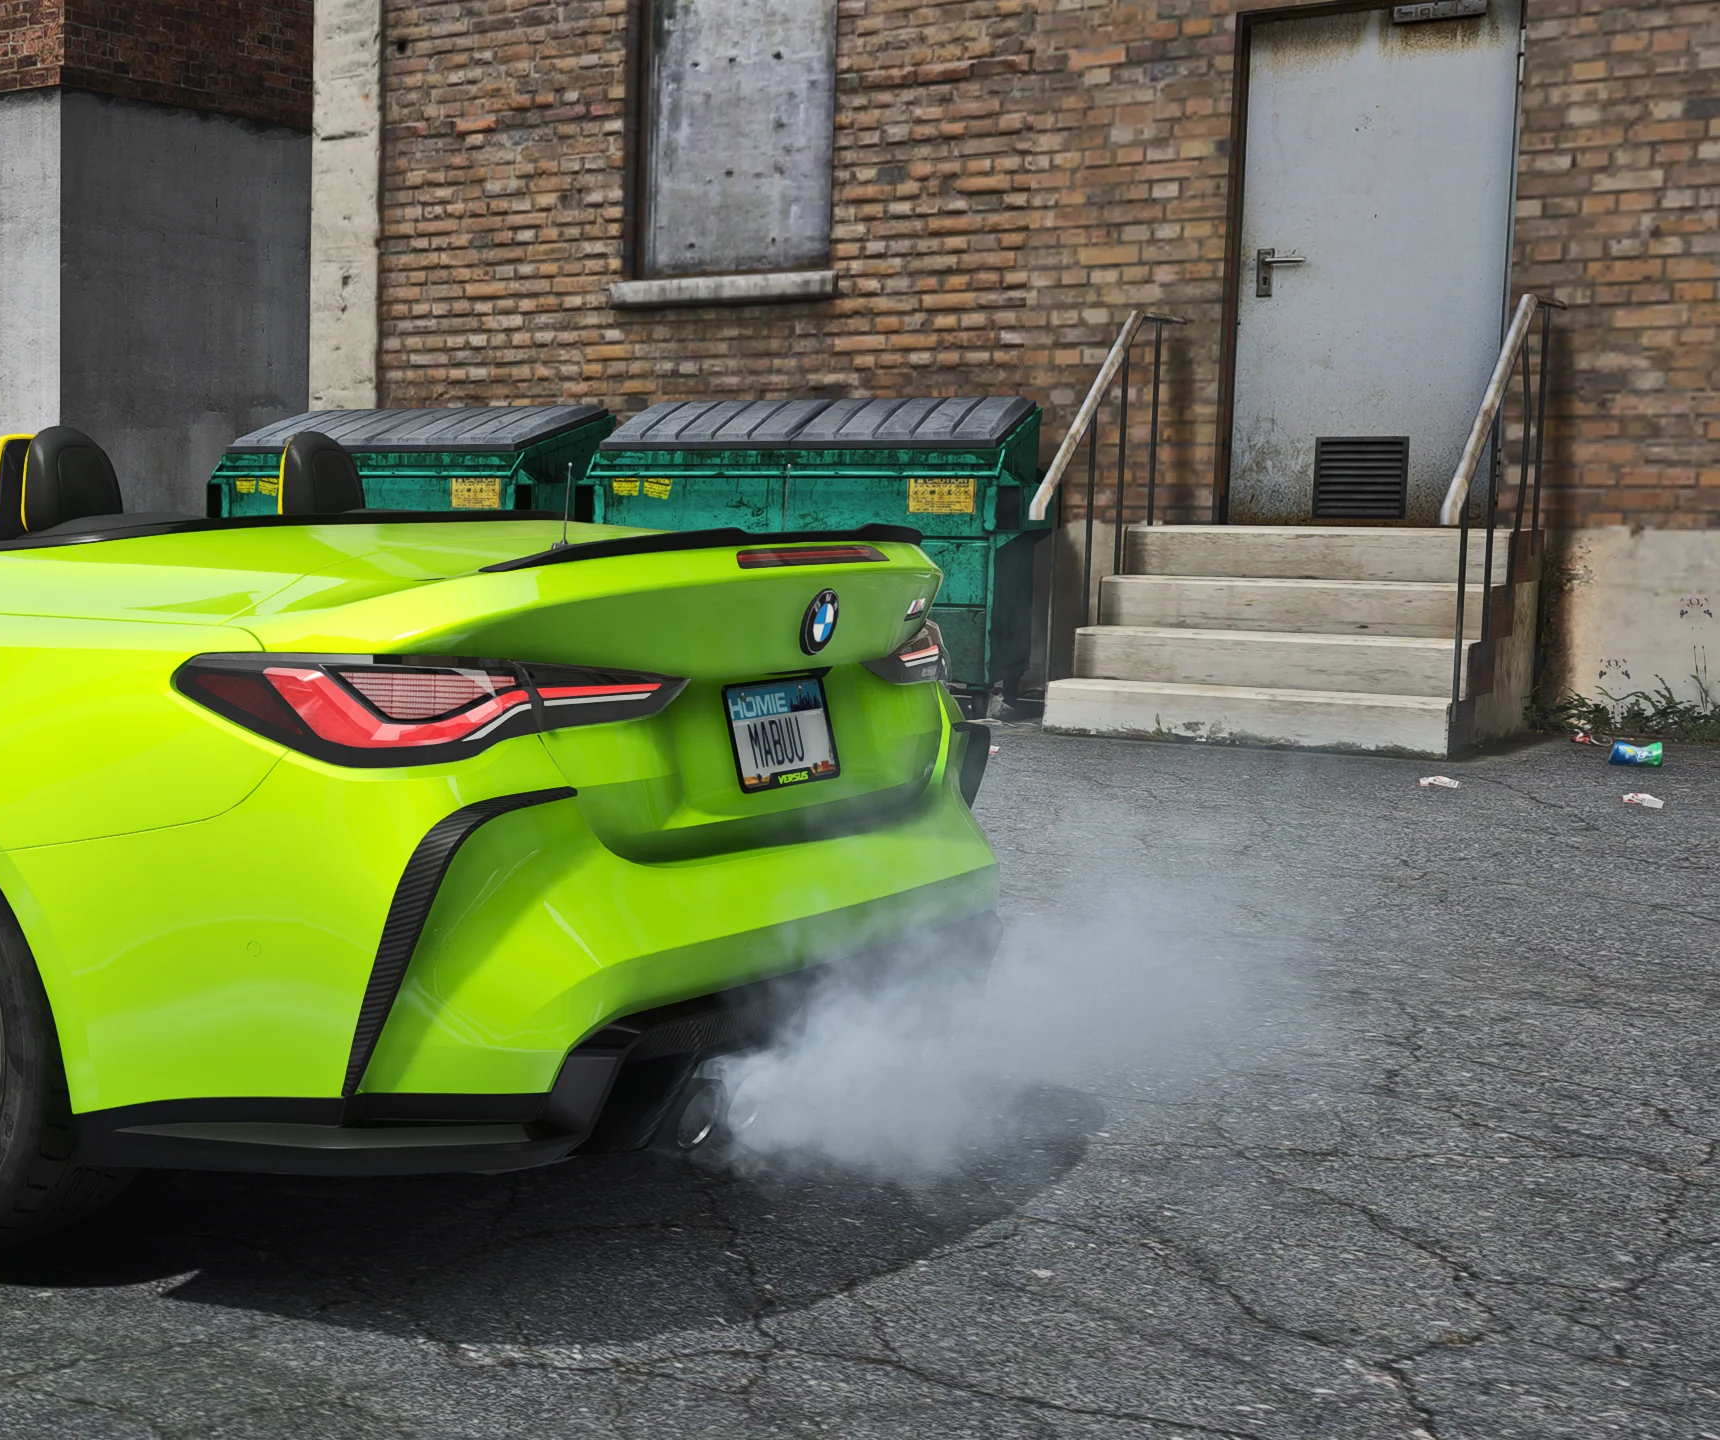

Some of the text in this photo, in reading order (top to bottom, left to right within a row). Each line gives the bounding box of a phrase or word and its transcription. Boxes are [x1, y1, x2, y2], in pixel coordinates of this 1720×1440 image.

[728, 692, 788, 720] HOMIE
[747, 715, 805, 769] MABUU
[778, 771, 808, 784] VERSUS
